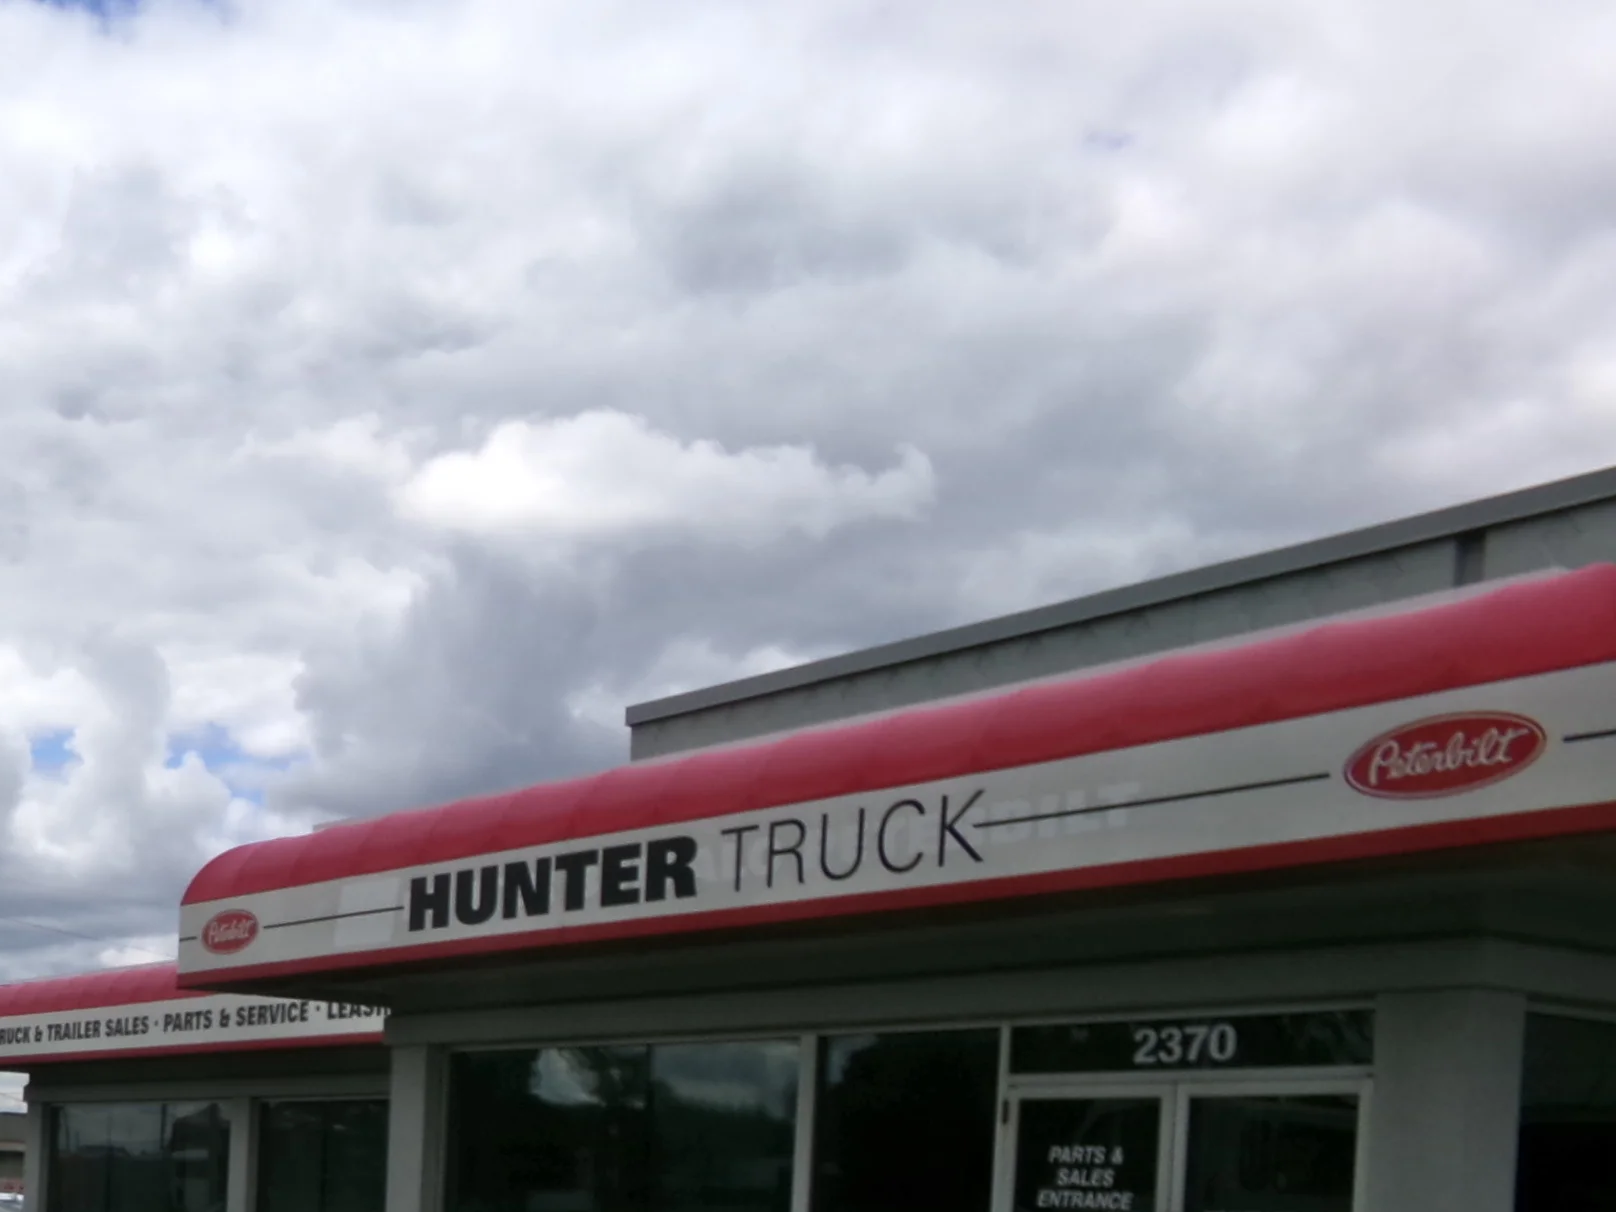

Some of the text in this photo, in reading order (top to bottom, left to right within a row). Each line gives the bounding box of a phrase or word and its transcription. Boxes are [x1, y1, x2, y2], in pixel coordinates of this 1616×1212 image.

[1369, 727, 1529, 786] Peterbilt
[408, 835, 698, 931] HUNTER
[720, 789, 986, 892] TRUCK
[34, 1025, 44, 1043] &
[47, 1020, 102, 1042] TRAILER
[104, 1015, 149, 1037] SALES
[163, 1009, 213, 1033] PARTS
[219, 1008, 231, 1029] &
[236, 1001, 310, 1027] SERVICE
[1132, 1023, 1238, 1066] 2370
[1047, 1144, 1125, 1166] PARTS &
[1056, 1167, 1116, 1188] SALES
[1036, 1189, 1135, 1212] ENTRANCE
